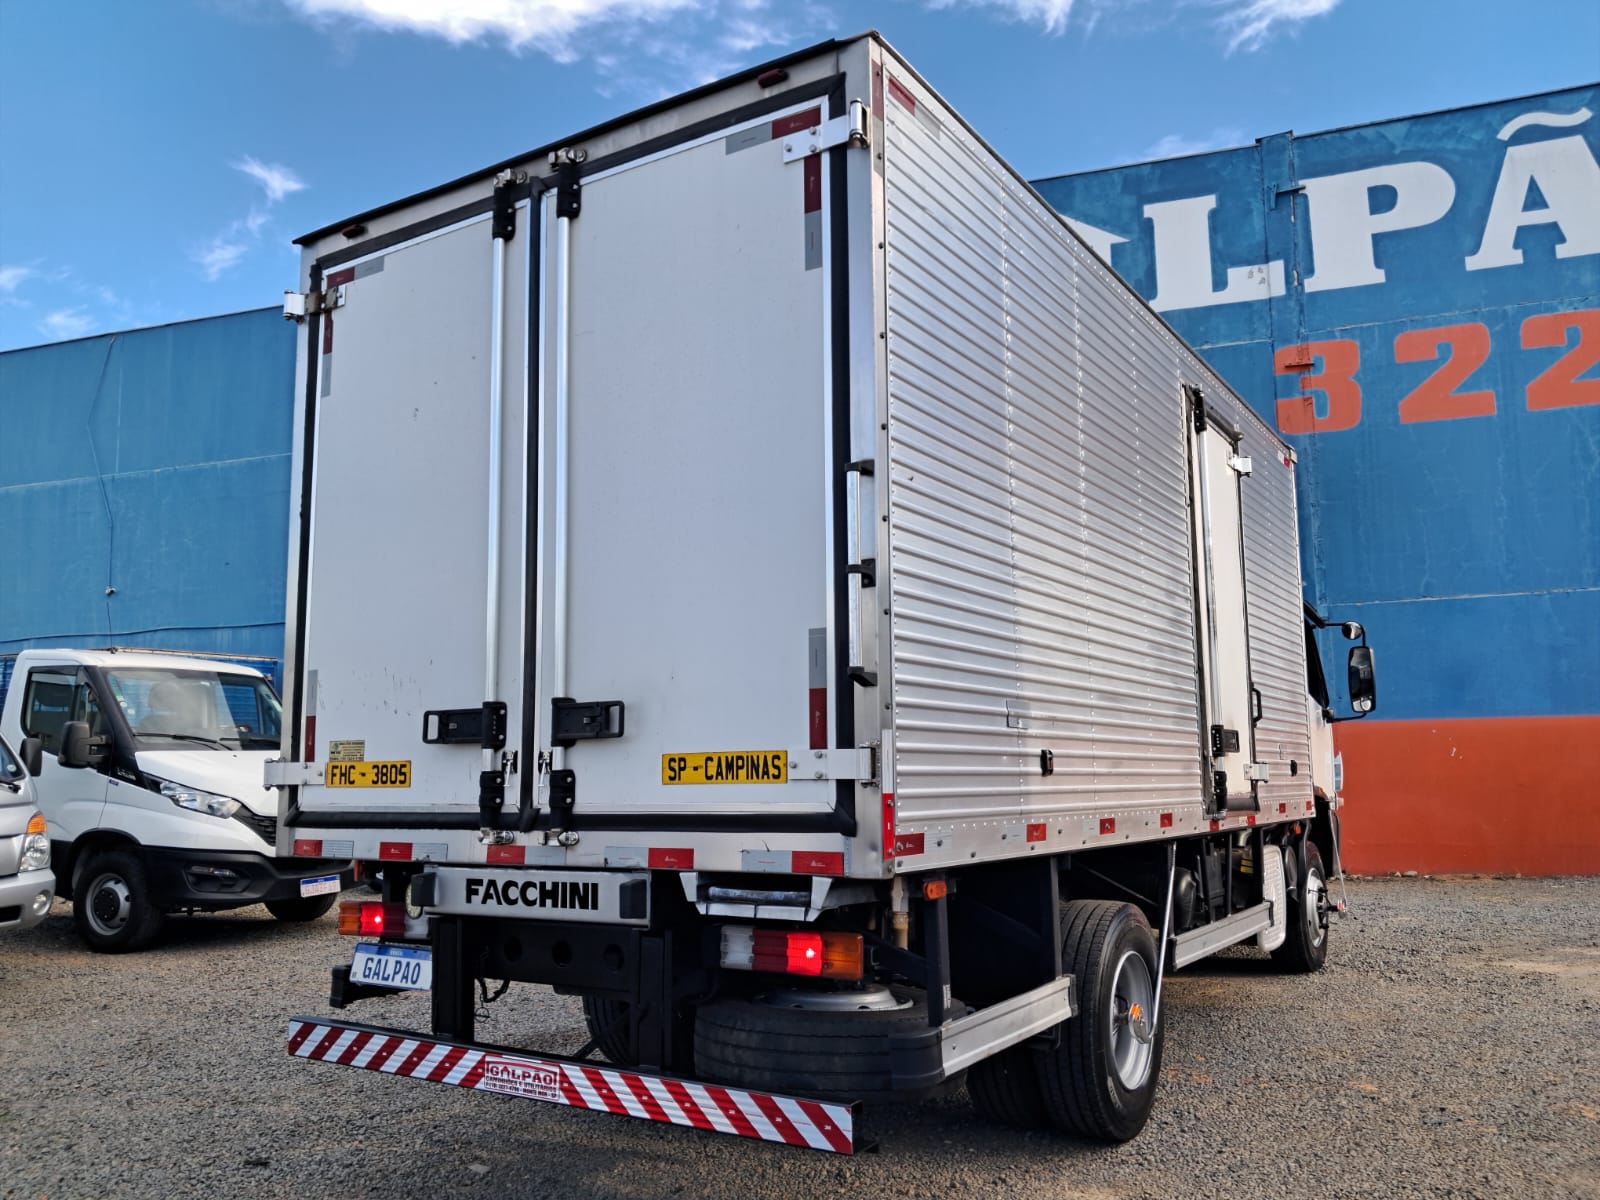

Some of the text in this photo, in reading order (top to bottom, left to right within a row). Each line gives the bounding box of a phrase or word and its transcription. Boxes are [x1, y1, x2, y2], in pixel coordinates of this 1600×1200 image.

[1057, 106, 1600, 313] LPÃ
[1273, 308, 1600, 435] 322
[330, 764, 356, 785] FHC
[371, 763, 407, 785] 3805
[668, 757, 687, 781] SP
[704, 754, 781, 781] CAMPINAS
[465, 878, 599, 911] FACCHINI
[363, 957, 421, 985] GALPAO
